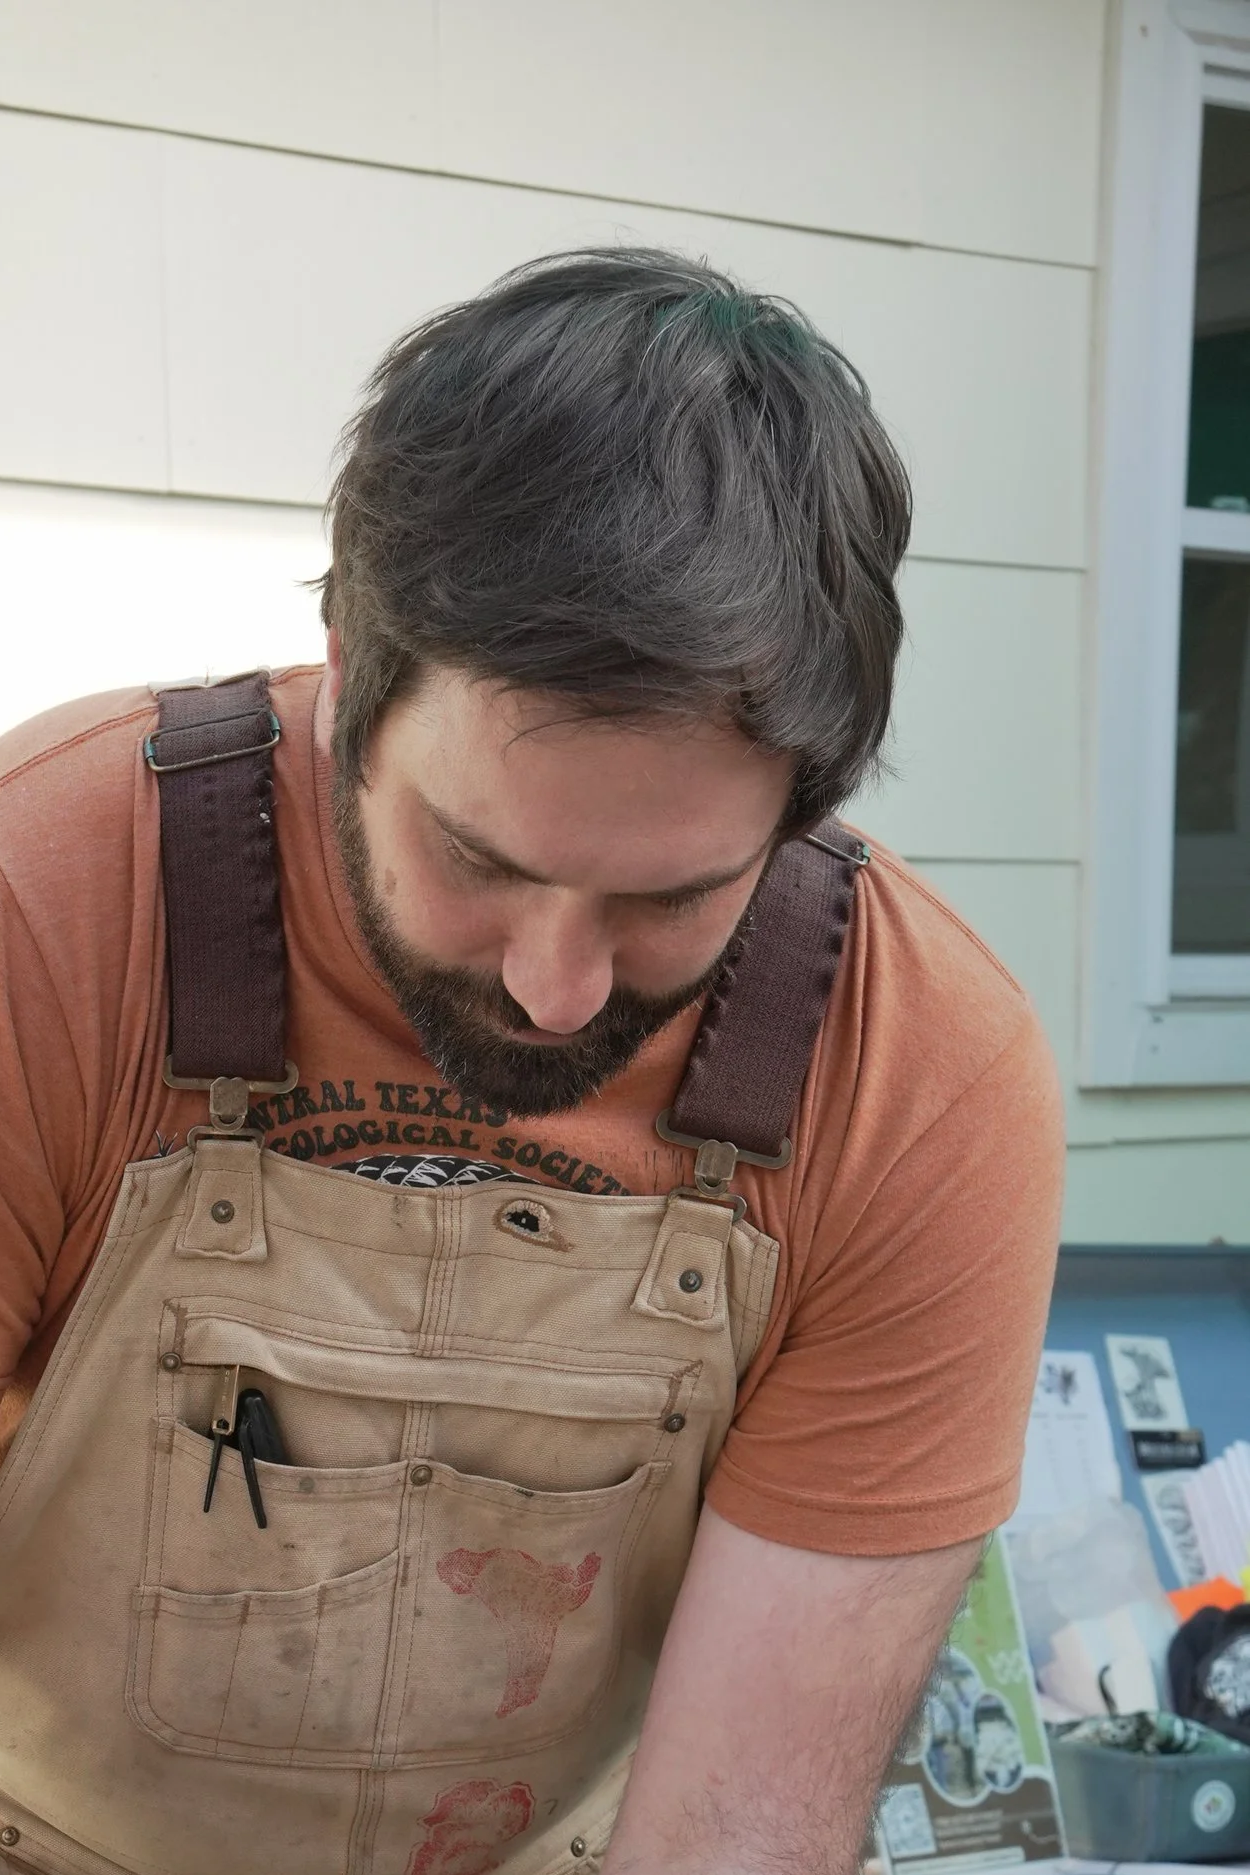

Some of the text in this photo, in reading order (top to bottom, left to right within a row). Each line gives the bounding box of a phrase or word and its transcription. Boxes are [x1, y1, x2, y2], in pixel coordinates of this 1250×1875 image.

[246, 1080, 366, 1132] NTRAL
[269, 1120, 632, 1196] COLOGICAL SOCIET
